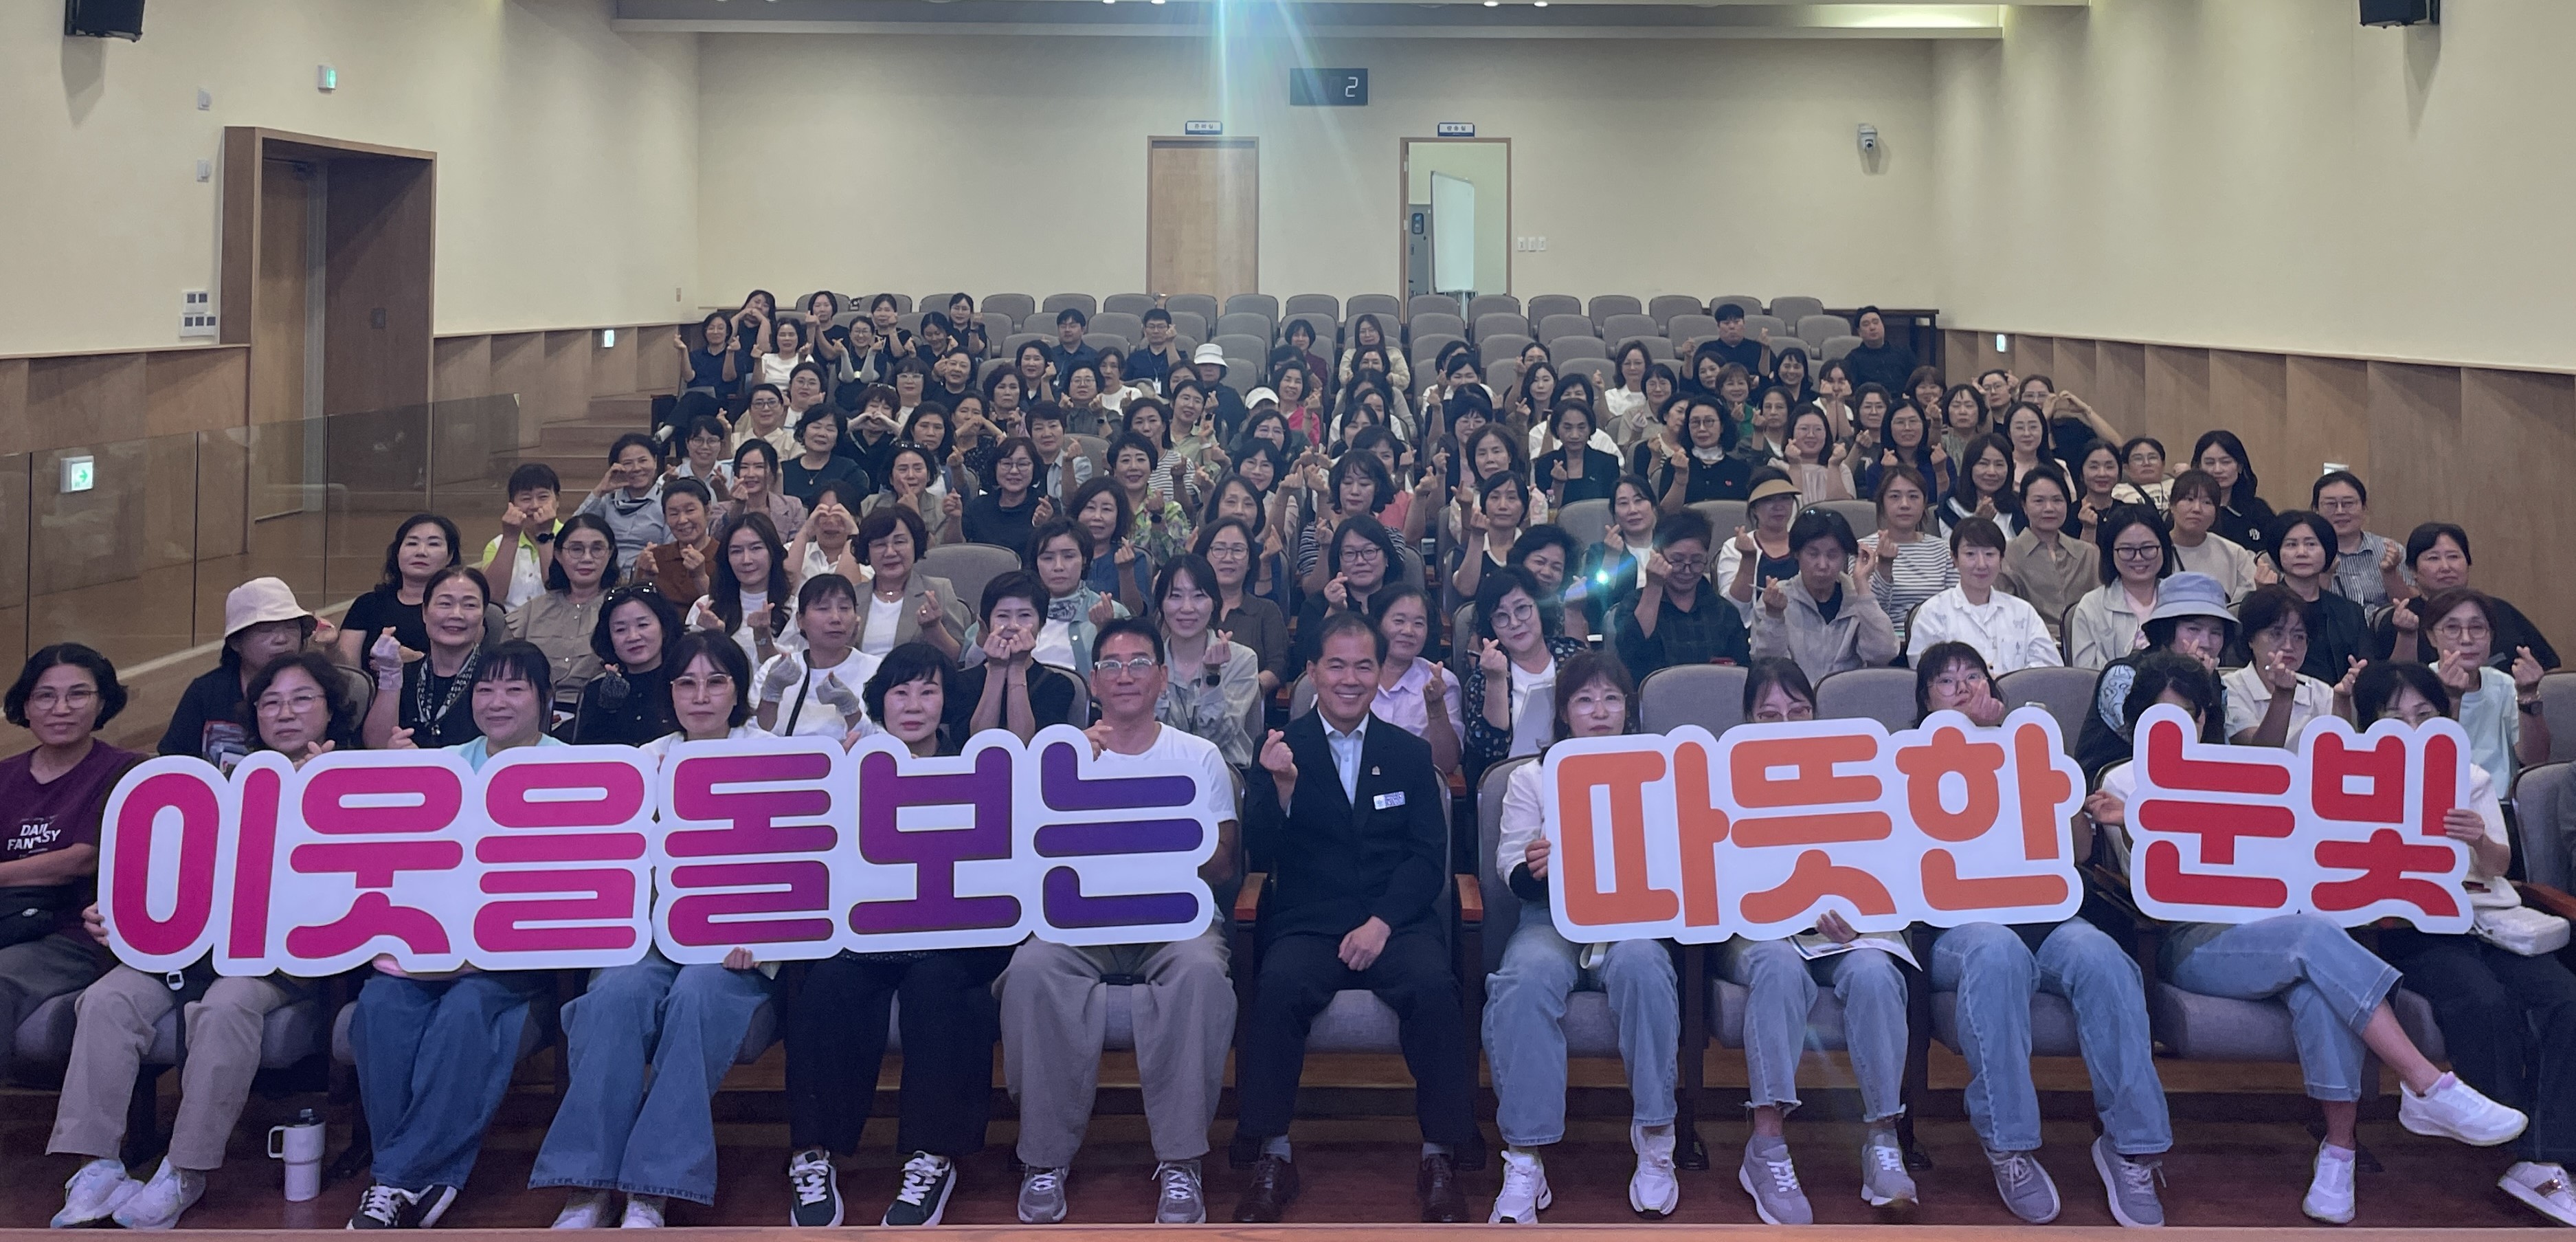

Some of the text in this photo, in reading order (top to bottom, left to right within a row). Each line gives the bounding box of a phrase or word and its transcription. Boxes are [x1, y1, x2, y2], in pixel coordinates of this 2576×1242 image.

[1345, 76, 1358, 98] 2
[1558, 724, 2070, 926] 따뜻한
[2139, 720, 2461, 916] 눈빛
